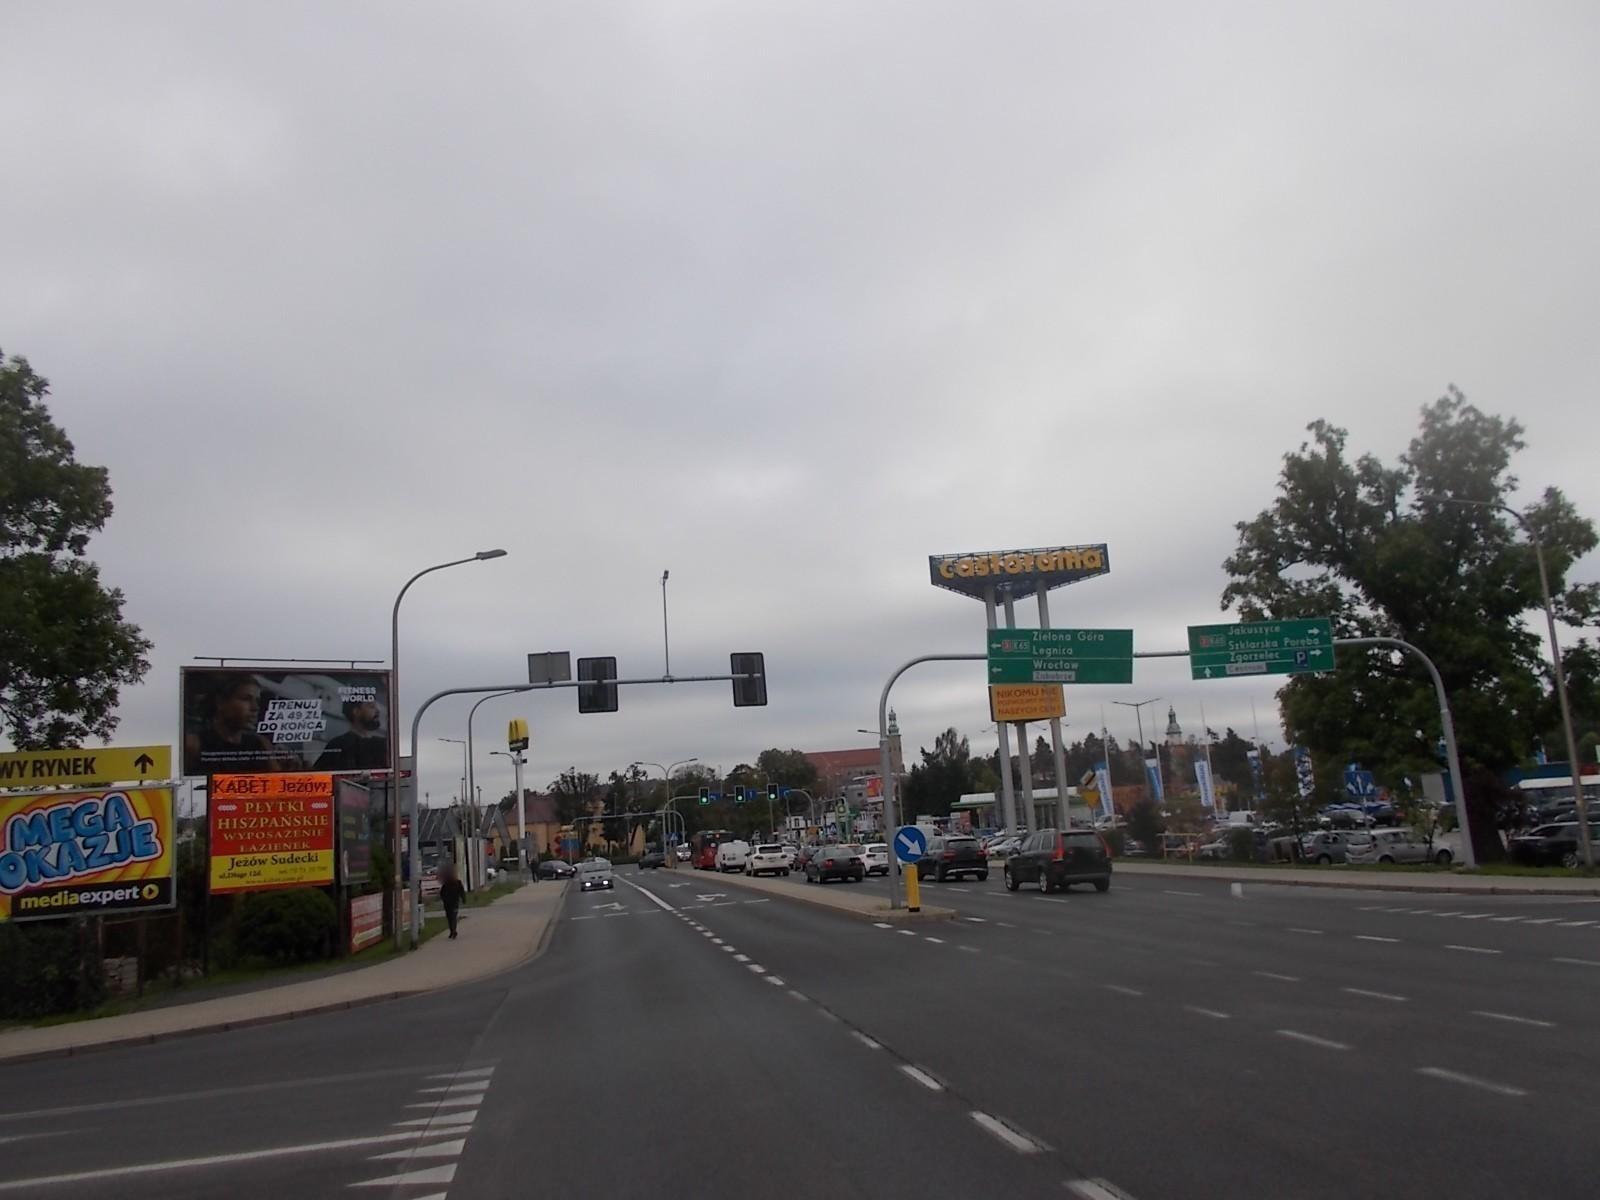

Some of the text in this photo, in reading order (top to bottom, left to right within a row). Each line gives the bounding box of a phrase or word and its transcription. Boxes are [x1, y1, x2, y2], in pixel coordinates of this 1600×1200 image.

[938, 547, 1102, 579] castorama
[1033, 630, 1105, 641] Zielona Góra
[1228, 625, 1281, 636] Jakuszyce
[1228, 640, 1279, 650] Szklarska
[1284, 636, 1320, 647] Poręba
[1033, 646, 1073, 658] Legnica
[1230, 651, 1280, 663] Zgorzelec
[1033, 660, 1079, 670] Wrocław
[338, 686, 376, 695] FITNESS
[996, 687, 1039, 698] NIKOMU
[341, 694, 375, 702] WORLD
[270, 701, 318, 710] TRENUJ
[267, 710, 320, 720] ZA 49 ZŁ
[259, 719, 323, 731] DO KOŃCA
[276, 731, 311, 741] ROKU
[32, 757, 97, 778] RYNEK
[213, 779, 270, 794] KABET
[244, 801, 305, 813] PŁYTKI
[10, 795, 134, 851] MEGA
[217, 814, 329, 830] HISZPAŃSKIE
[0, 823, 158, 889] OKAZJE
[228, 855, 268, 871] Jeżów
[270, 852, 319, 866] Sudecki
[20, 886, 141, 909] mediaexpert
